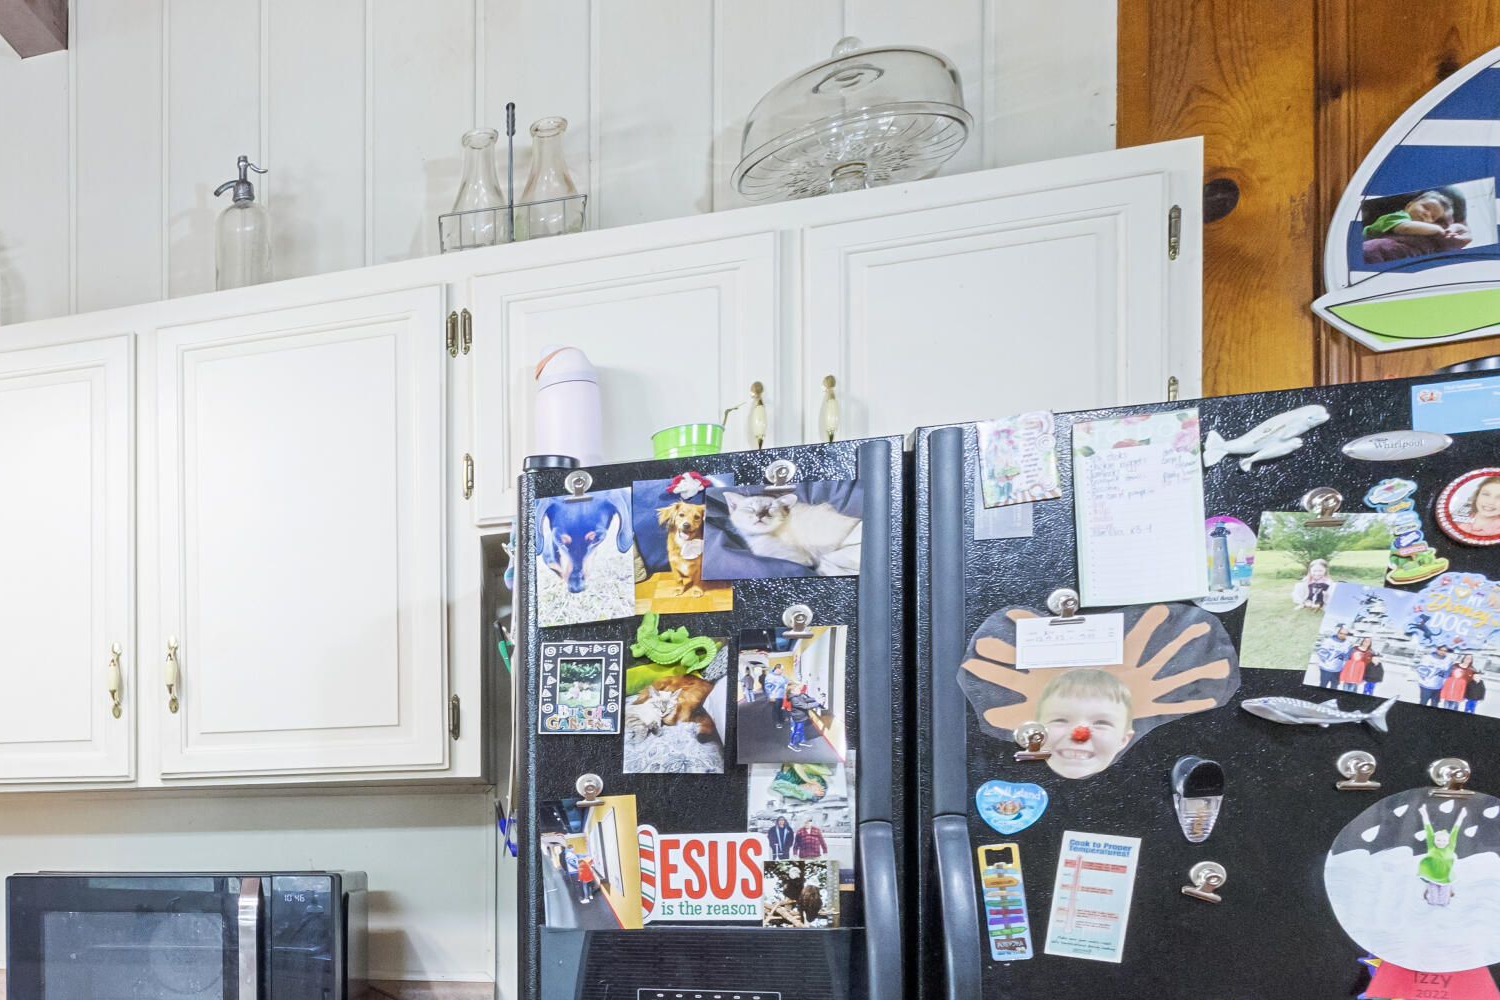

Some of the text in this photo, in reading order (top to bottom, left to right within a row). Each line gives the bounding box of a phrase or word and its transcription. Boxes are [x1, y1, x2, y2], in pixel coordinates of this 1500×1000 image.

[1373, 439, 1423, 450] Whirlpool
[1428, 593, 1494, 628] Disney
[1429, 611, 1473, 636] DOG
[1069, 839, 1133, 852] Cook to Proper
[1069, 845, 1131, 857] Temperatures!
[661, 900, 757, 916] is the reason
[1415, 989, 1451, 1000] 2022
